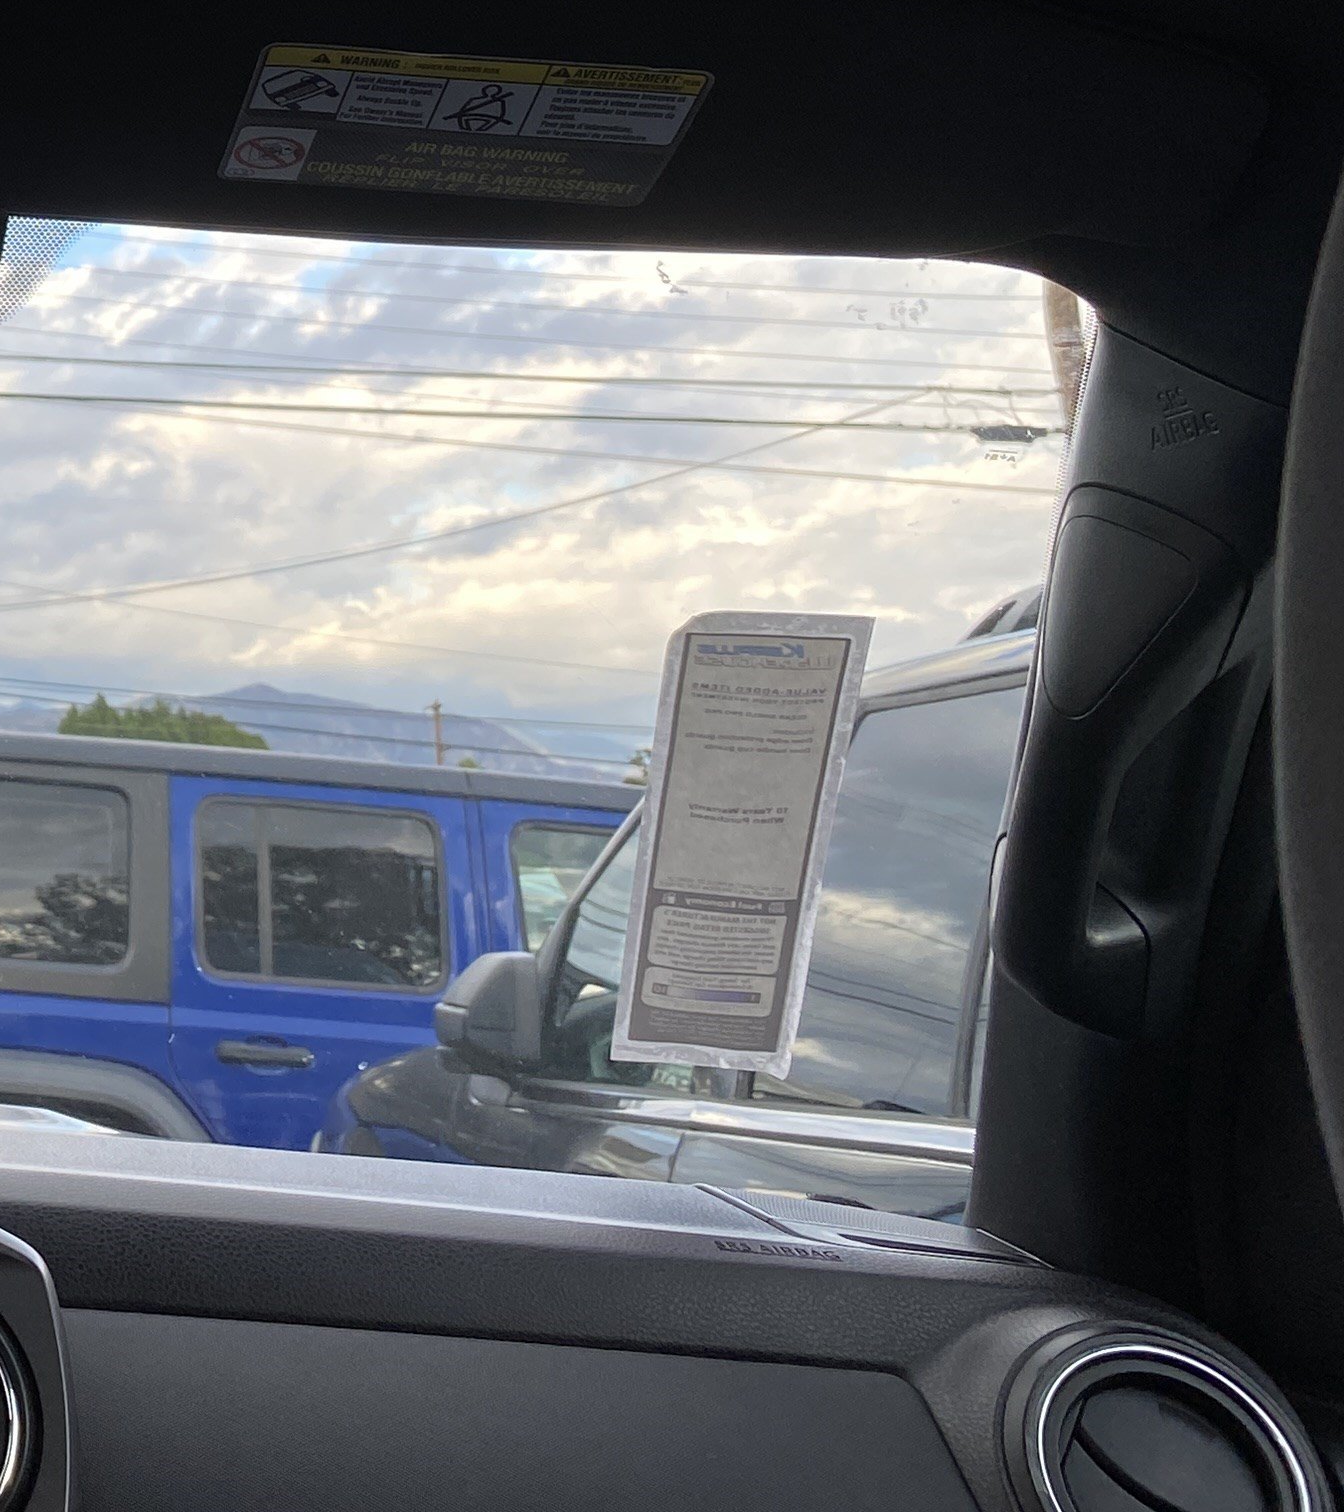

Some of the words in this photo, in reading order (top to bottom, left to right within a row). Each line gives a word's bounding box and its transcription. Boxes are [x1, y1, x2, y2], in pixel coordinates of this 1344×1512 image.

[404, 142, 436, 154] AIR
[440, 145, 476, 157] BAG
[481, 147, 569, 164] WARNING
[759, 1243, 843, 1262] AIRBAG
